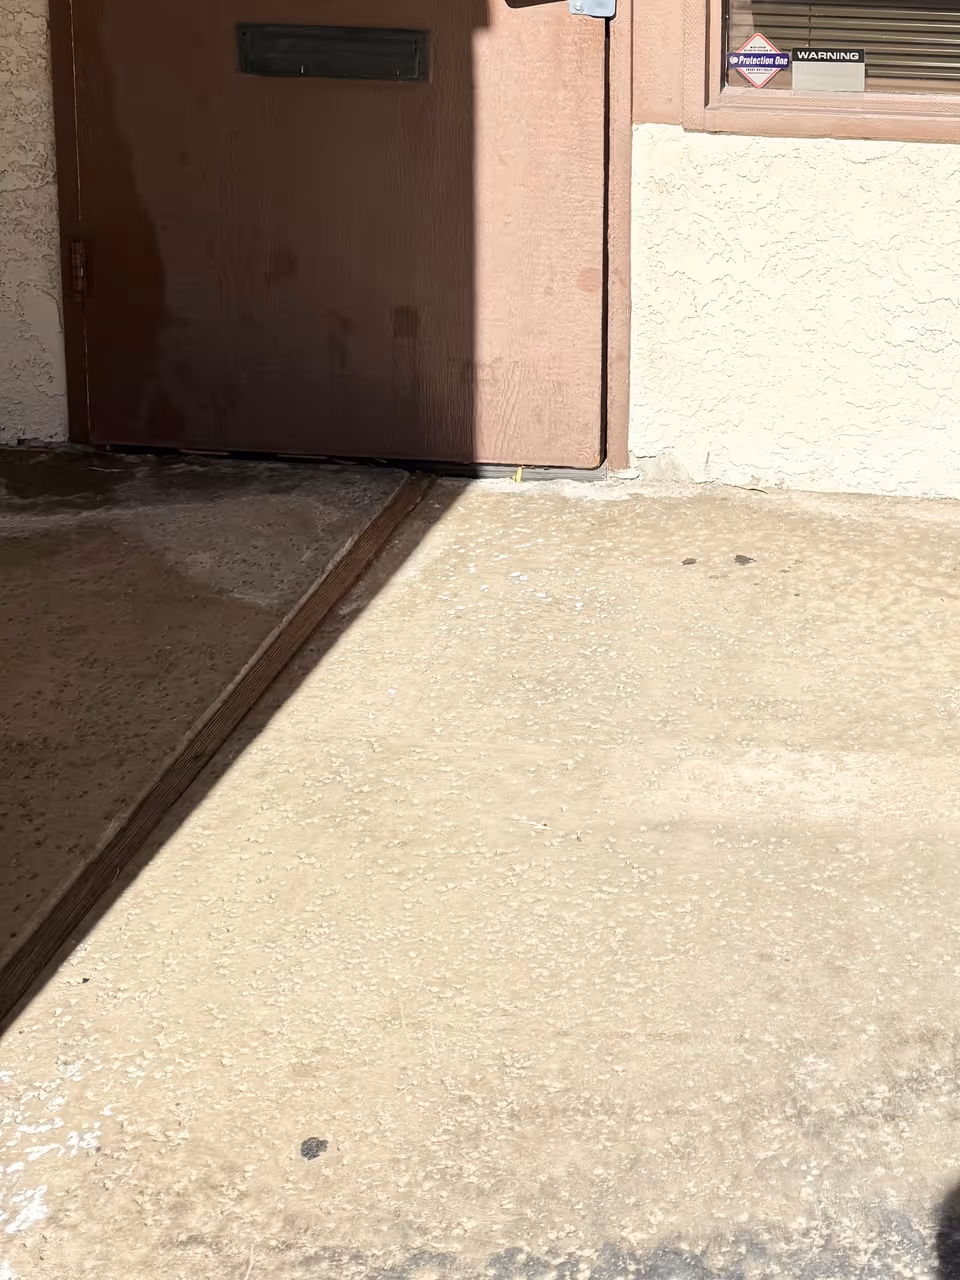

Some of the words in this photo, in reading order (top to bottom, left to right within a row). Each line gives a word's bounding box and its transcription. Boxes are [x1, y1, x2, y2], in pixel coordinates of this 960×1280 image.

[738, 55, 774, 65] Protection
[775, 56, 788, 65] One
[797, 51, 859, 60] WARNING
